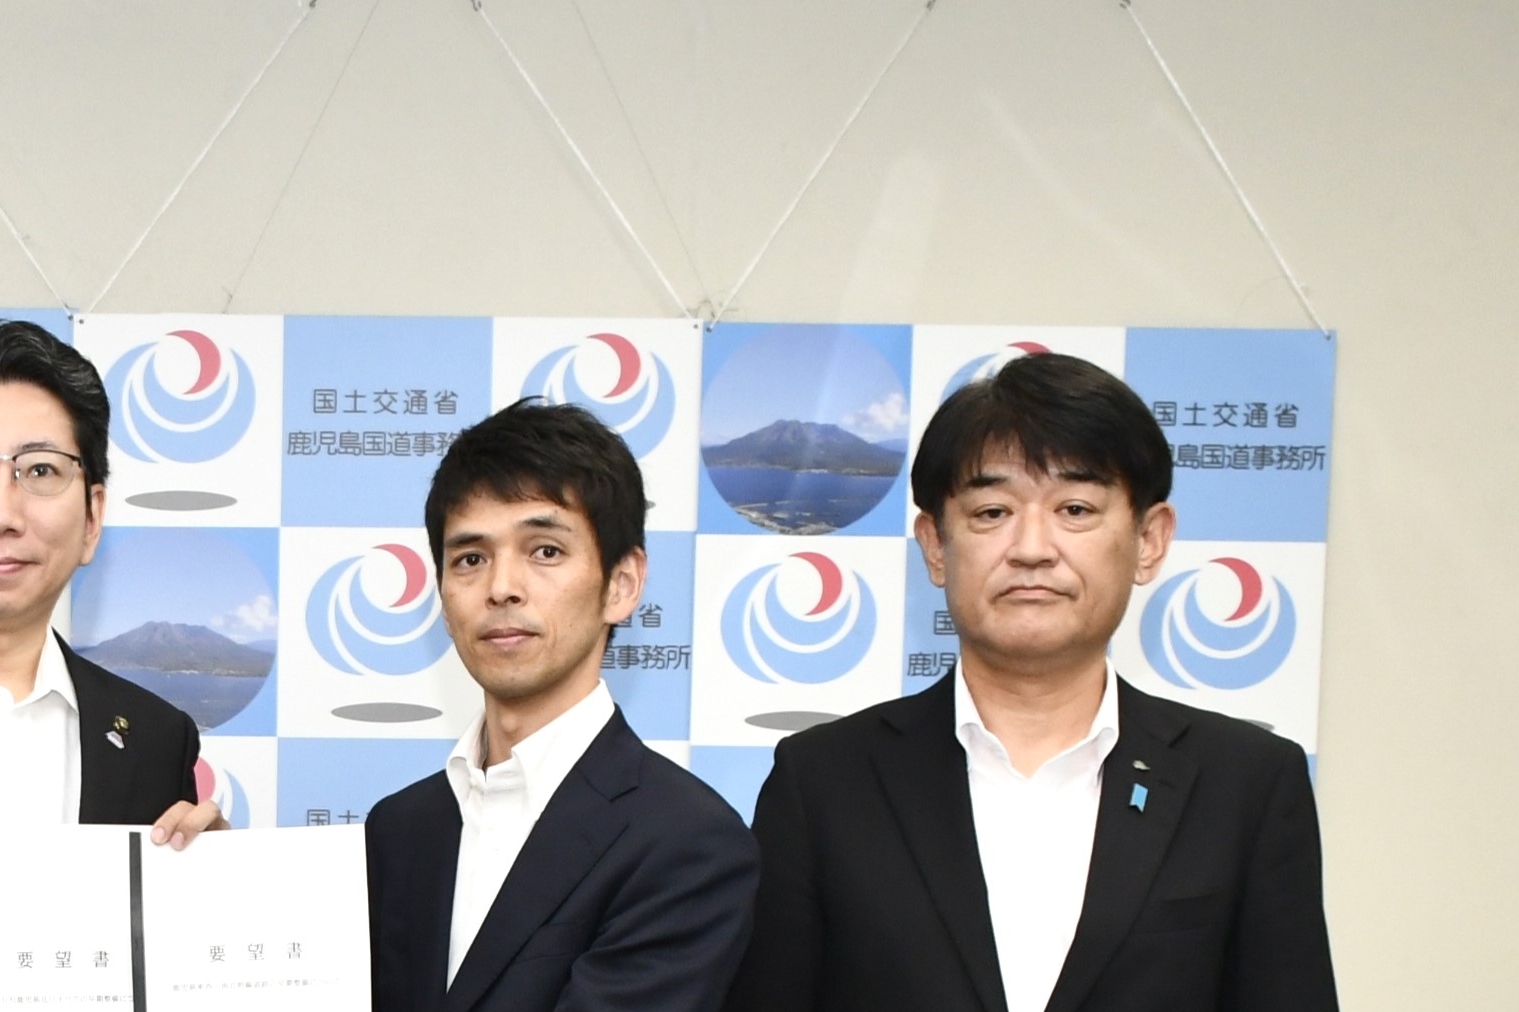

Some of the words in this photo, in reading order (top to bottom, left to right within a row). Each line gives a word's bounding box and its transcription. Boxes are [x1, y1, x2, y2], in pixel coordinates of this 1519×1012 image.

[312, 388, 459, 415] 国土交通省
[1153, 400, 1299, 428] 国土交通省
[287, 429, 461, 457] 鹿児島国道事務
[1172, 444, 1326, 471] 島国道事務所
[600, 644, 691, 670] 道事務所
[17, 950, 110, 969] 要望書
[209, 941, 303, 963] 要望書
